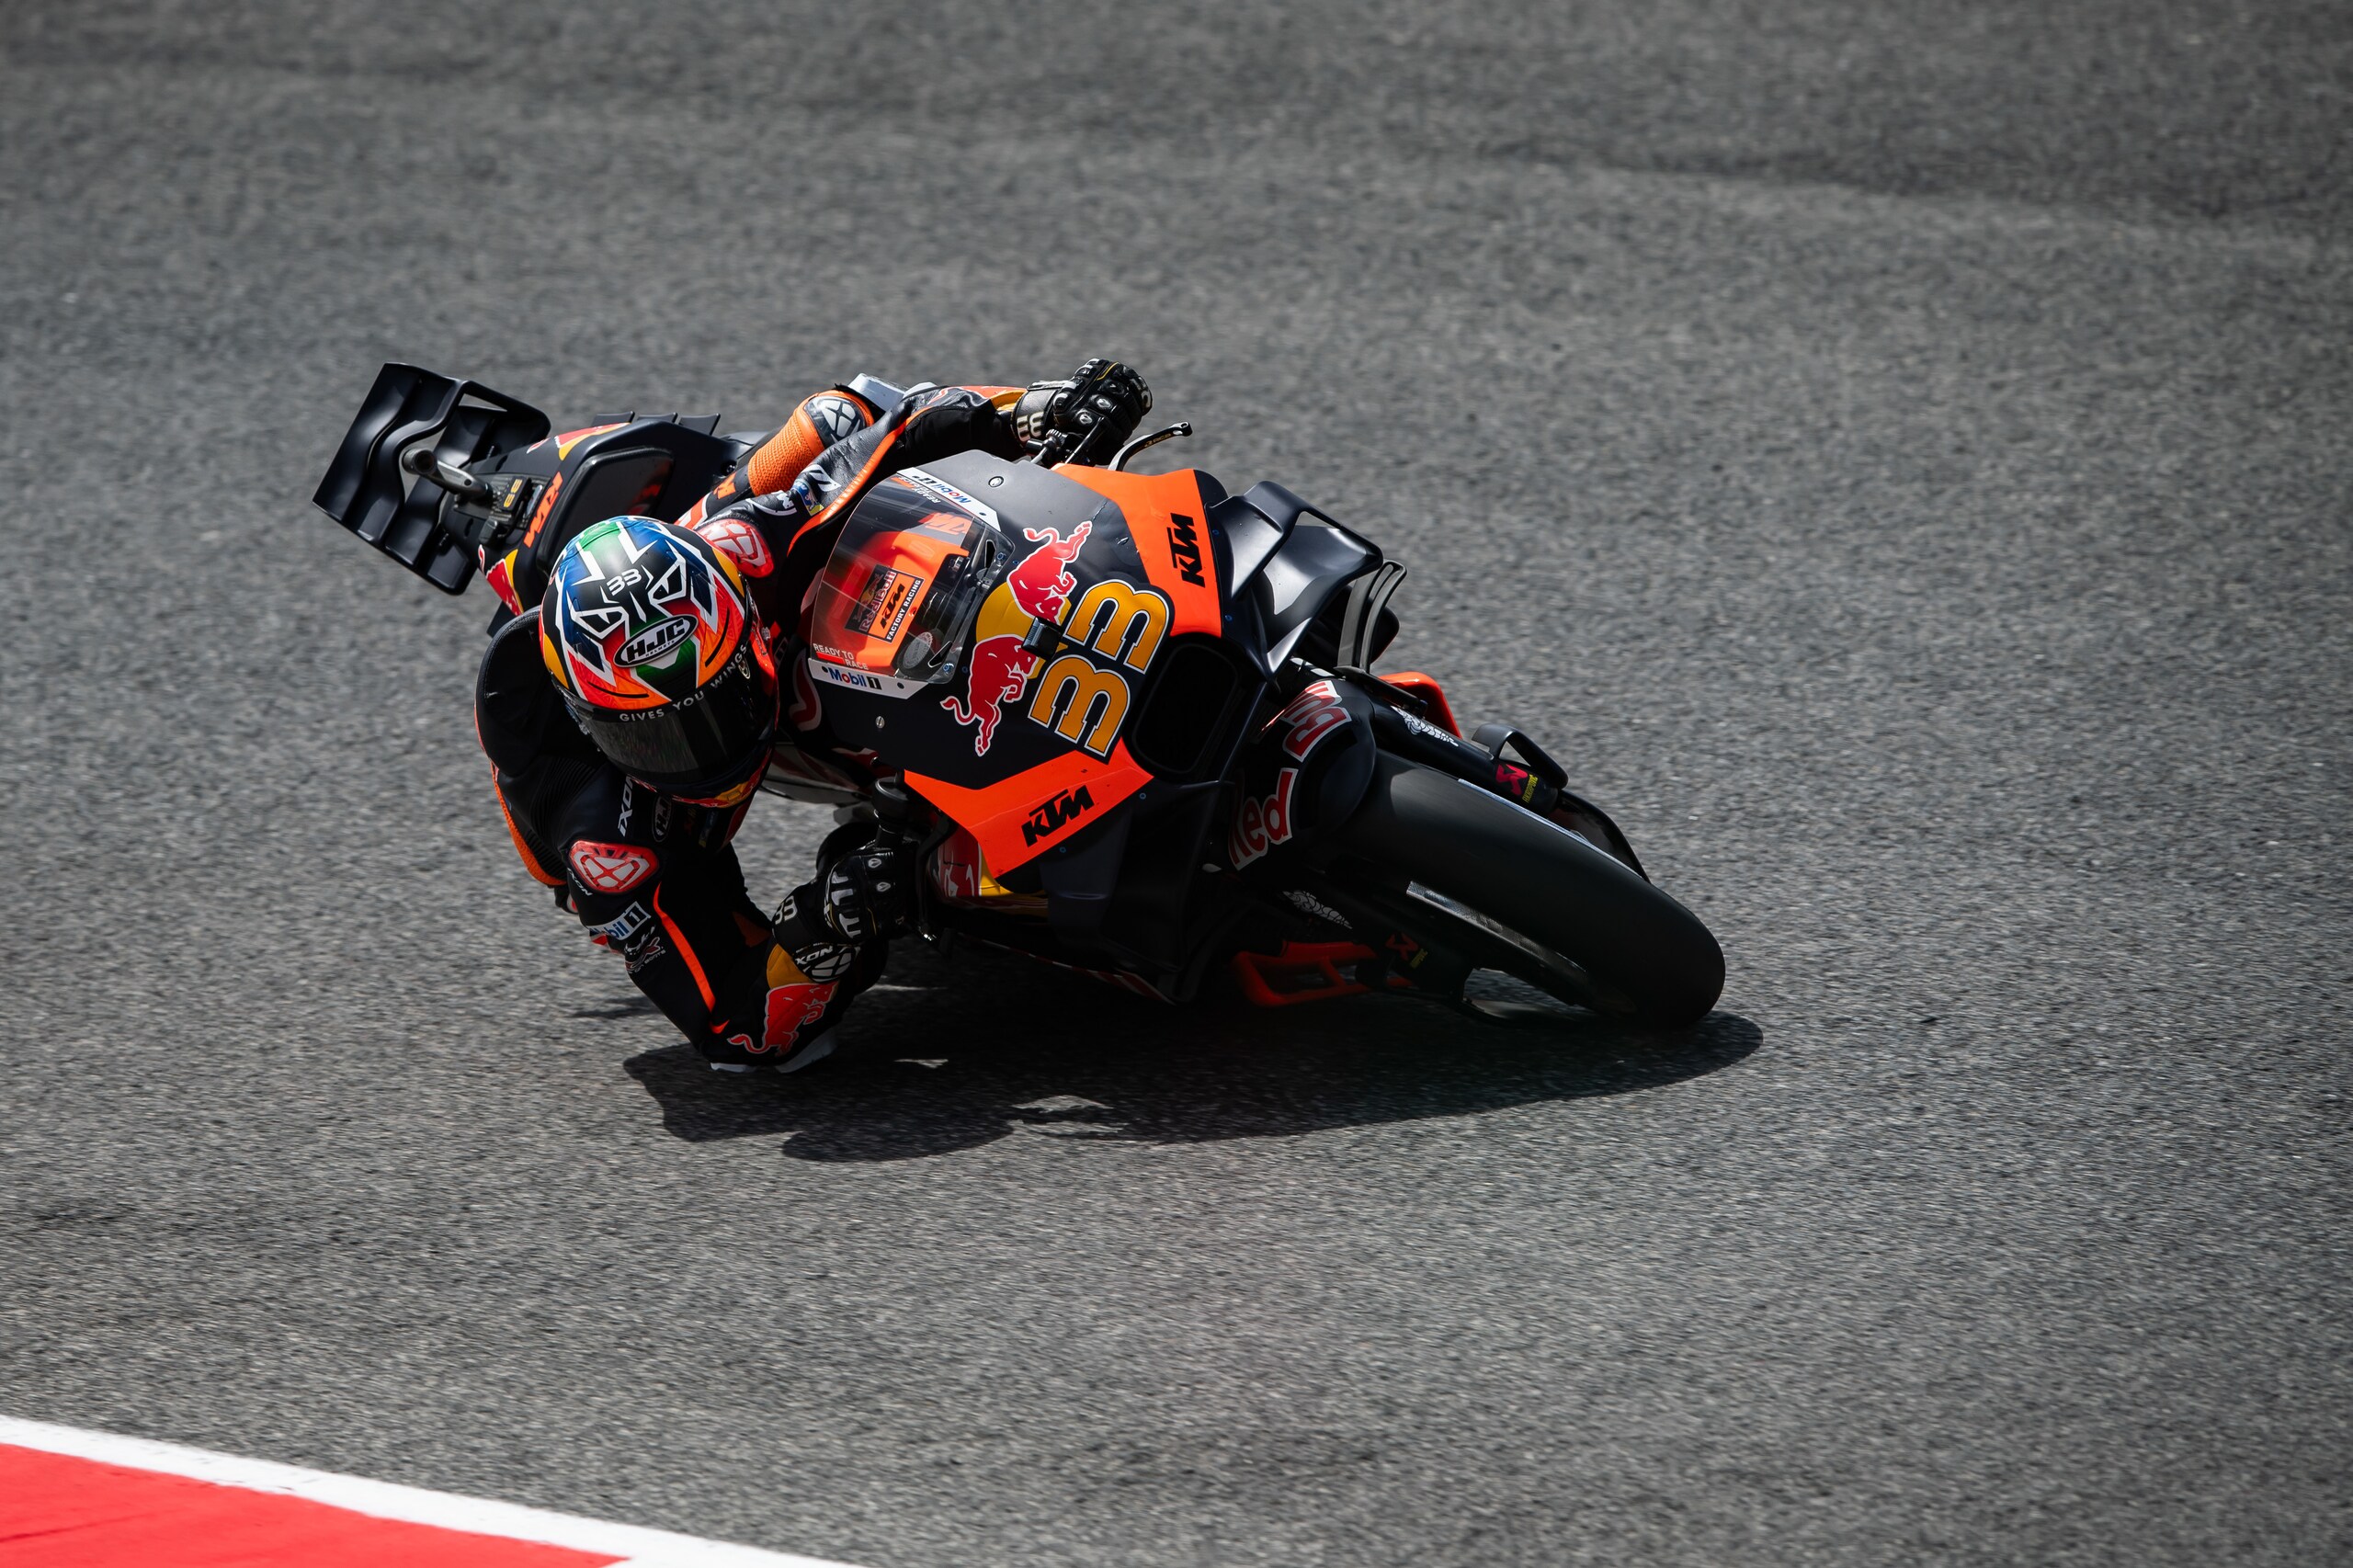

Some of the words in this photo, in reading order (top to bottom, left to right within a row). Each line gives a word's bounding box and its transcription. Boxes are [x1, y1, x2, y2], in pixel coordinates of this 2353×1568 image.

[523, 471, 563, 549] KTM
[934, 483, 972, 504] Mobil
[1167, 512, 1206, 588] KTM
[606, 568, 642, 597] 33
[858, 599, 881, 632] Red
[879, 570, 898, 601] Bull
[880, 583, 905, 630] KTM
[886, 608, 905, 641] FACTORY
[903, 579, 922, 608] RACING
[626, 619, 686, 664] HJC
[813, 642, 842, 657] READY
[842, 650, 854, 660] TO
[844, 658, 870, 671] RACE
[620, 708, 665, 722] GIVES
[672, 690, 705, 711] YOU
[710, 643, 747, 689] WINGS
[827, 667, 868, 687] Mobil
[1029, 580, 1172, 758] 33
[1021, 786, 1096, 848] KTM
[795, 945, 834, 966] XON
